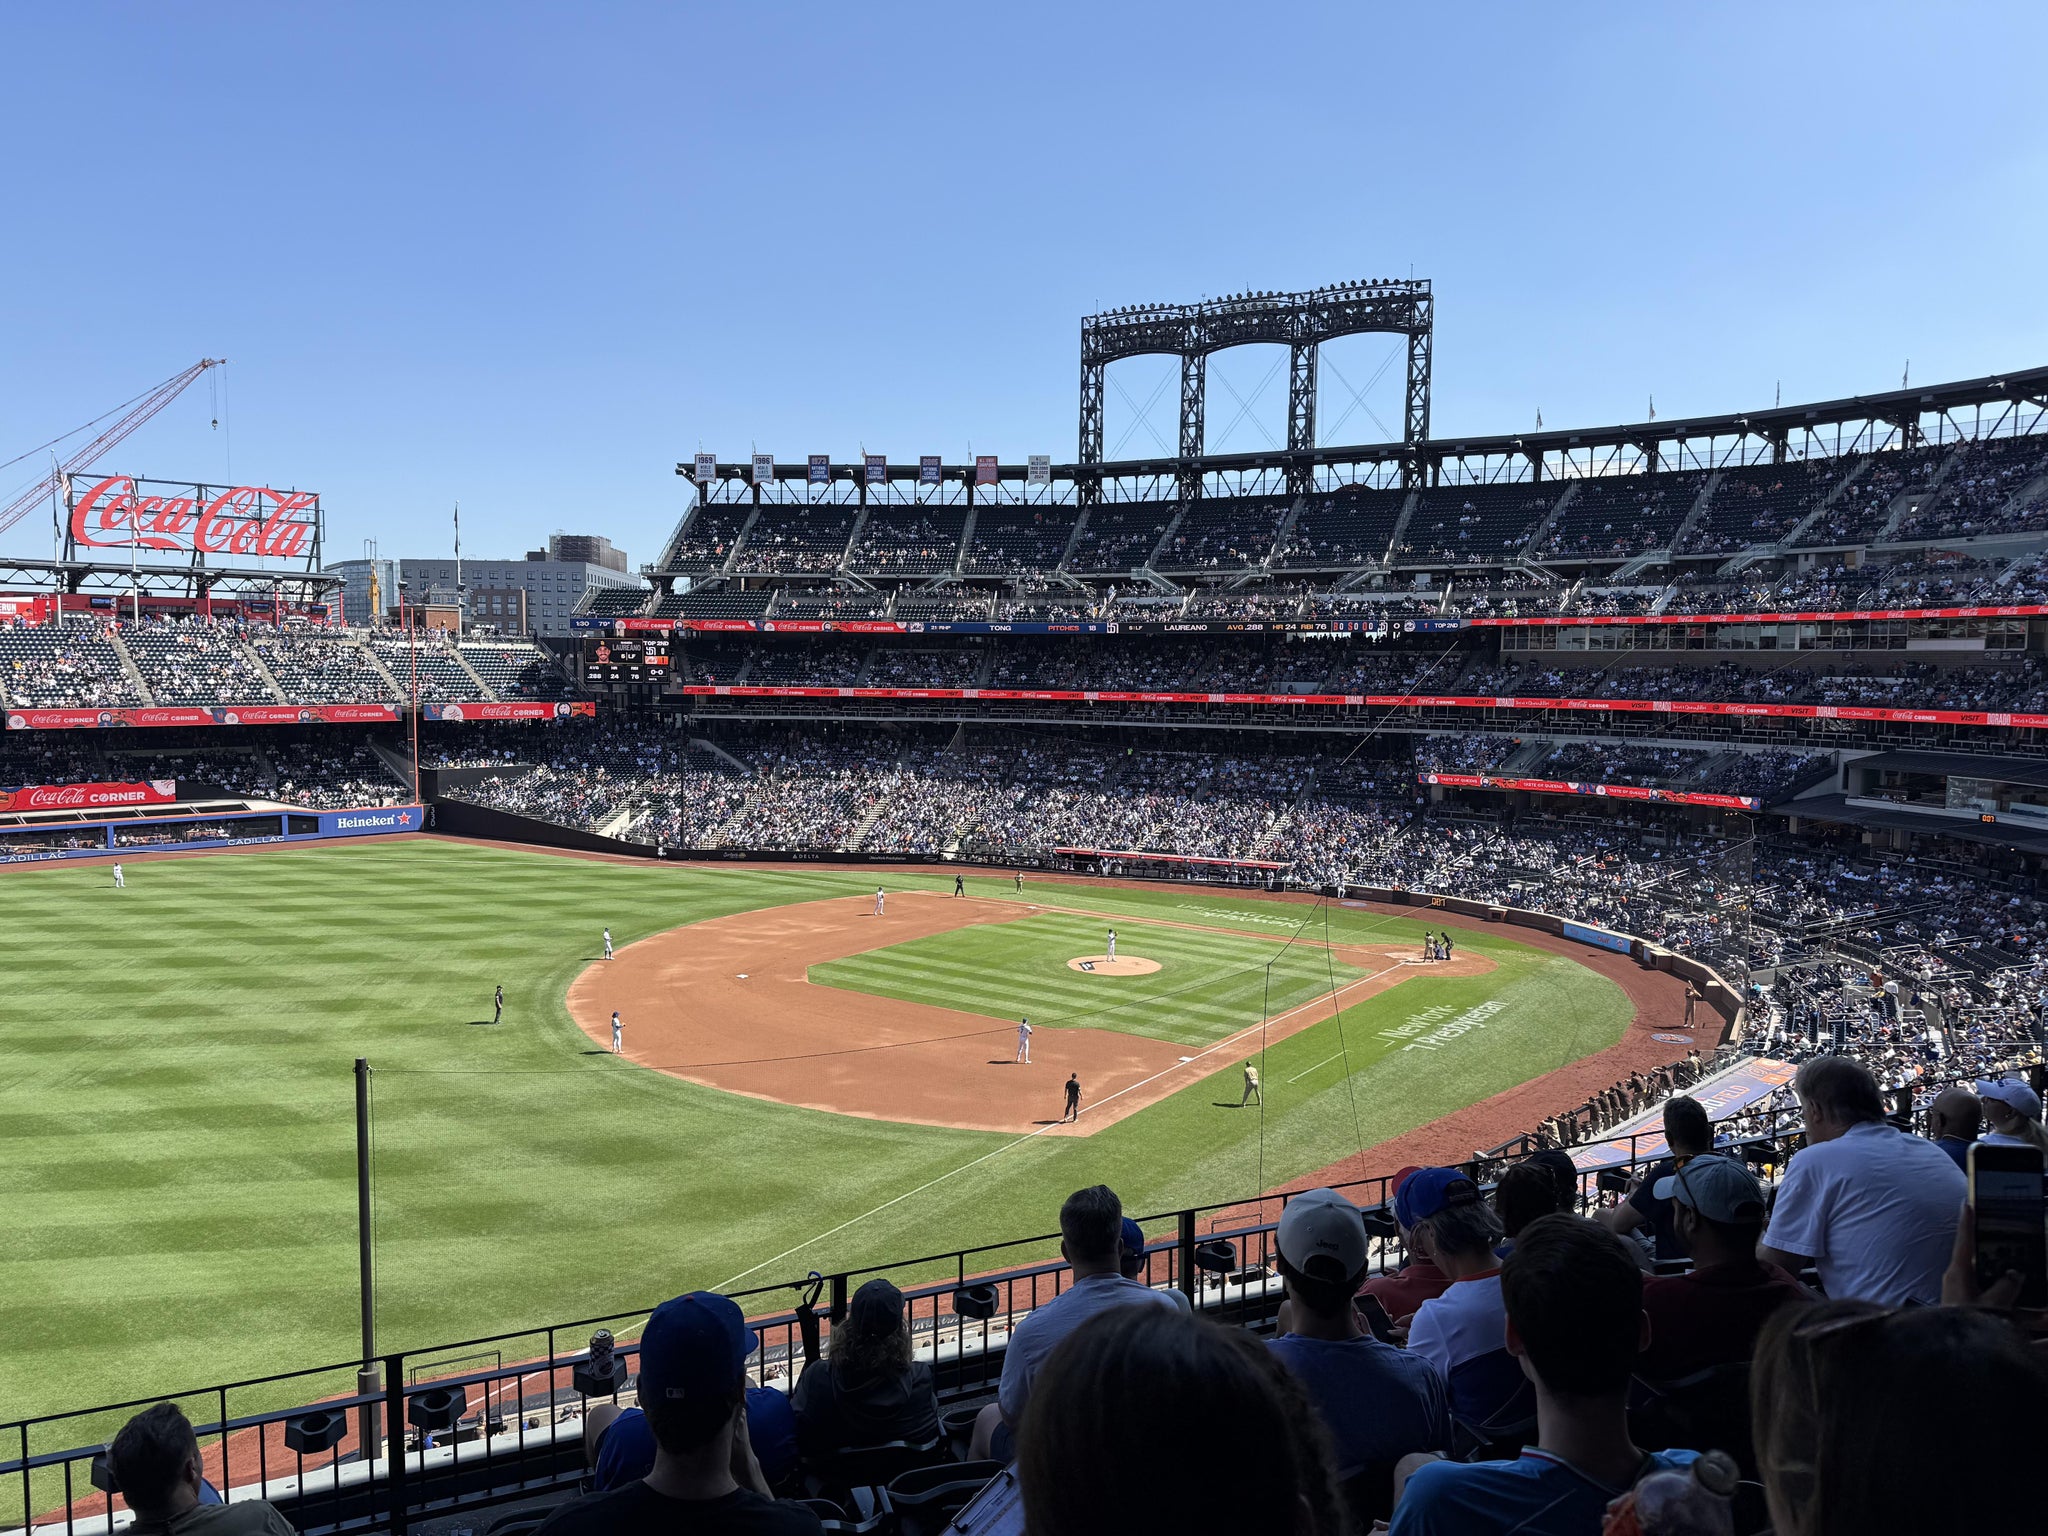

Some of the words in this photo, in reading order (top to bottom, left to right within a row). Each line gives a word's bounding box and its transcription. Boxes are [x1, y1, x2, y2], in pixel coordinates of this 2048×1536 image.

[755, 457, 770, 465] 1986
[72, 475, 320, 557] Coca-Cola
[481, 705, 512, 716] Coca-Cola
[1726, 705, 1745, 713] Coca-Cola
[1816, 706, 1837, 717] DORADO
[1893, 711, 1913, 719] Coca-Cola
[1987, 713, 2011, 725] DORADO
[30, 787, 88, 806] Coca-Cola
[90, 791, 146, 803] CORNER
[337, 814, 395, 829] Heineken
[227, 835, 285, 846] CADILLAC
[0, 851, 67, 863] CADILLAC
[1315, 1239, 1339, 1250] Jeep
